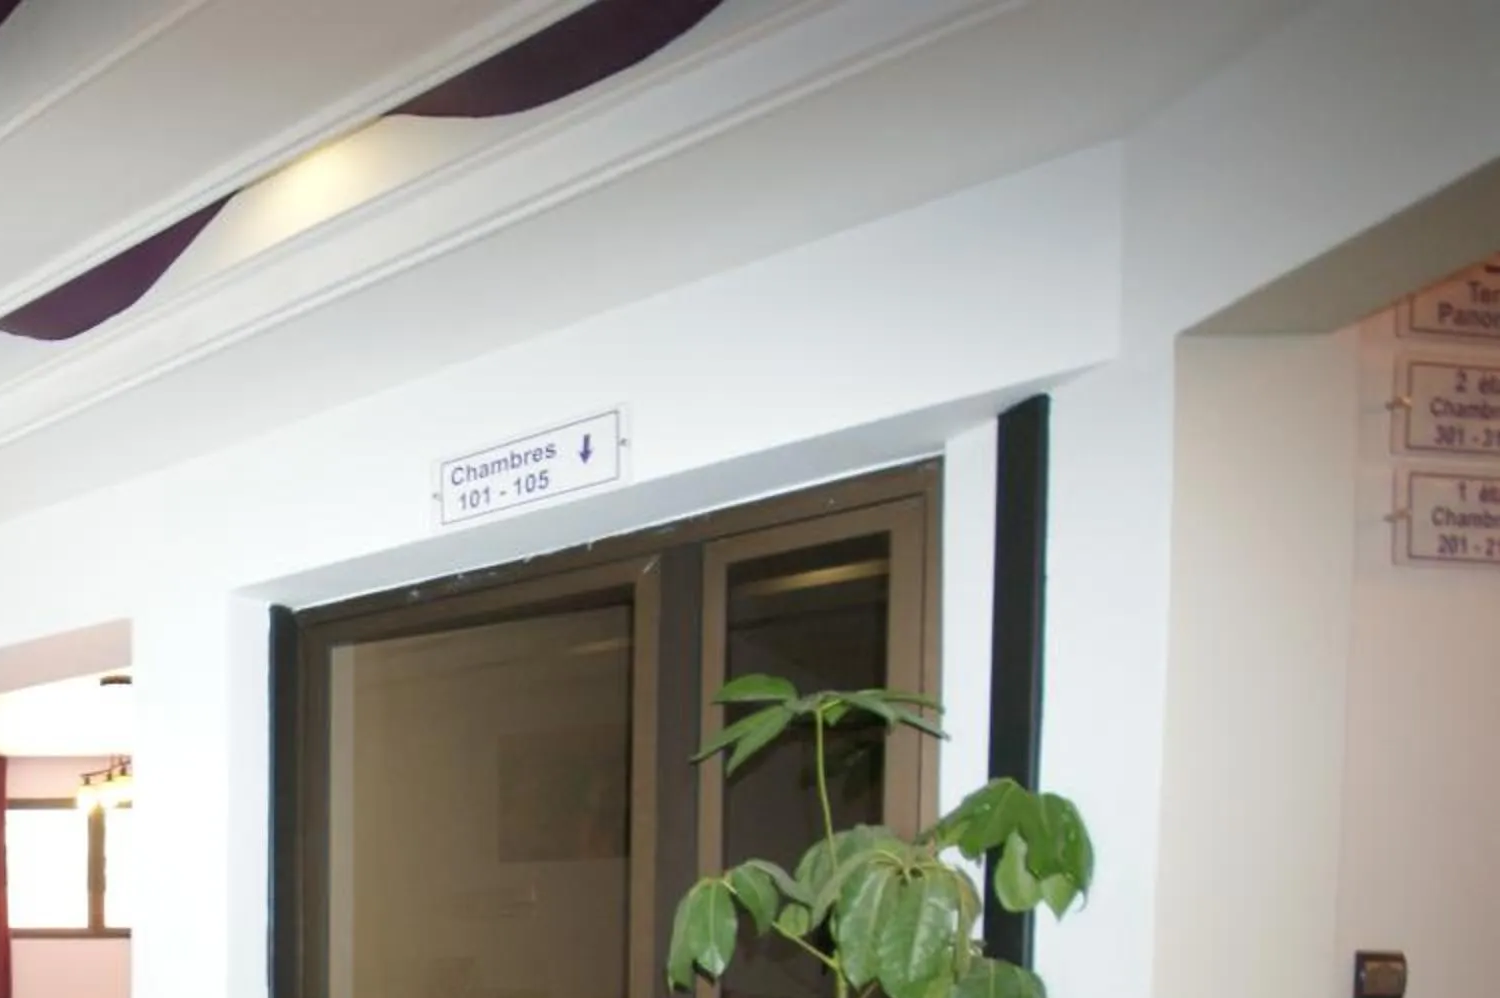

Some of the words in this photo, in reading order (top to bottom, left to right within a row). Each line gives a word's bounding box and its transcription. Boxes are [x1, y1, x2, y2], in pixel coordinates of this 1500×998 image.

[451, 442, 557, 486] Chambres
[458, 486, 491, 511] 101
[513, 470, 550, 497] 105
